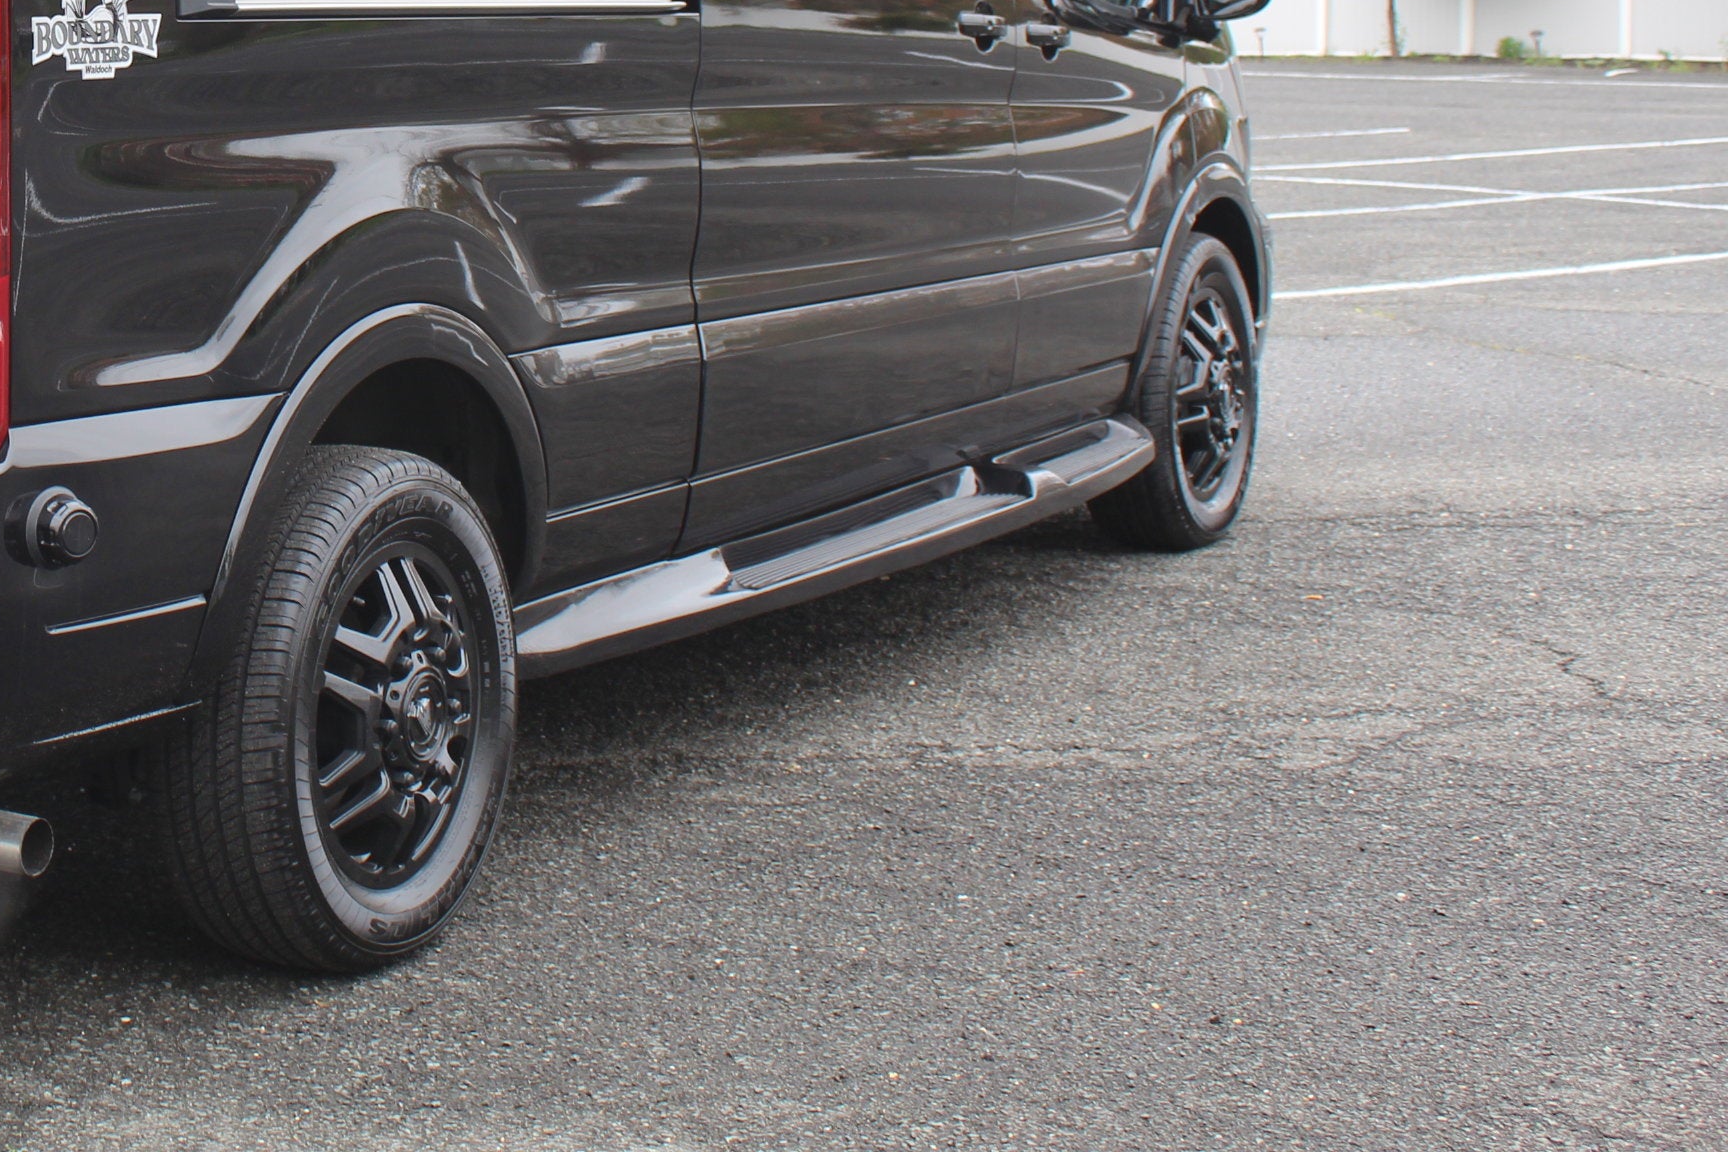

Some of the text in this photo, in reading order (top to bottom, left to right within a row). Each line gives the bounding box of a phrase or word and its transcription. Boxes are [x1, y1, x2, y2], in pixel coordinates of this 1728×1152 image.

[35, 18, 159, 58] BOUNDARY
[67, 46, 130, 65] WATERS
[85, 65, 113, 75] Waldoch
